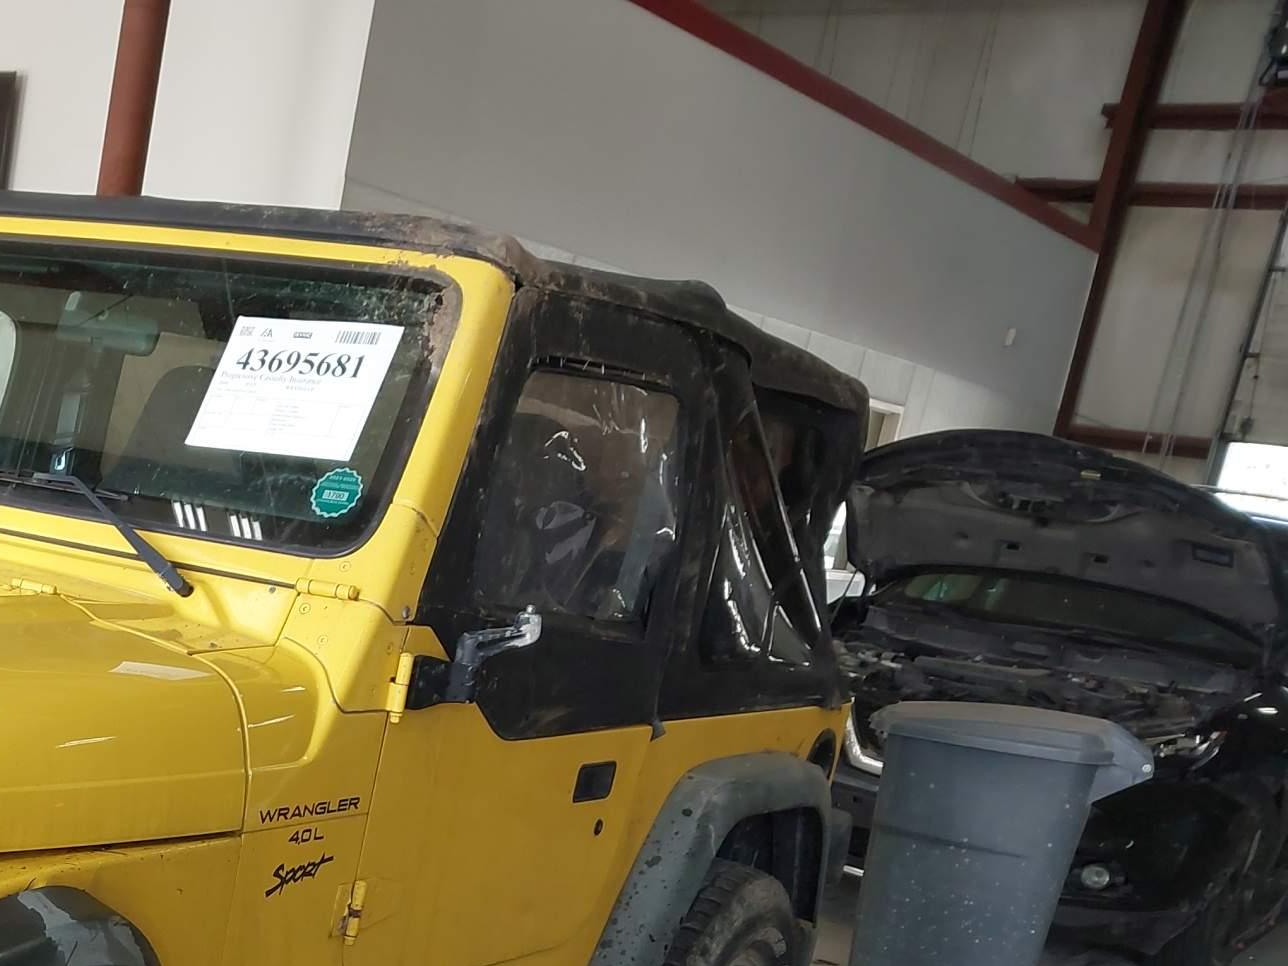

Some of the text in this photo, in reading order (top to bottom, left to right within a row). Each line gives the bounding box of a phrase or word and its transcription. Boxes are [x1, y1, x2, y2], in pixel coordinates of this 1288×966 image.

[236, 347, 365, 378] 43695681
[259, 797, 361, 824] WRANGLER
[265, 853, 334, 898] Sport
